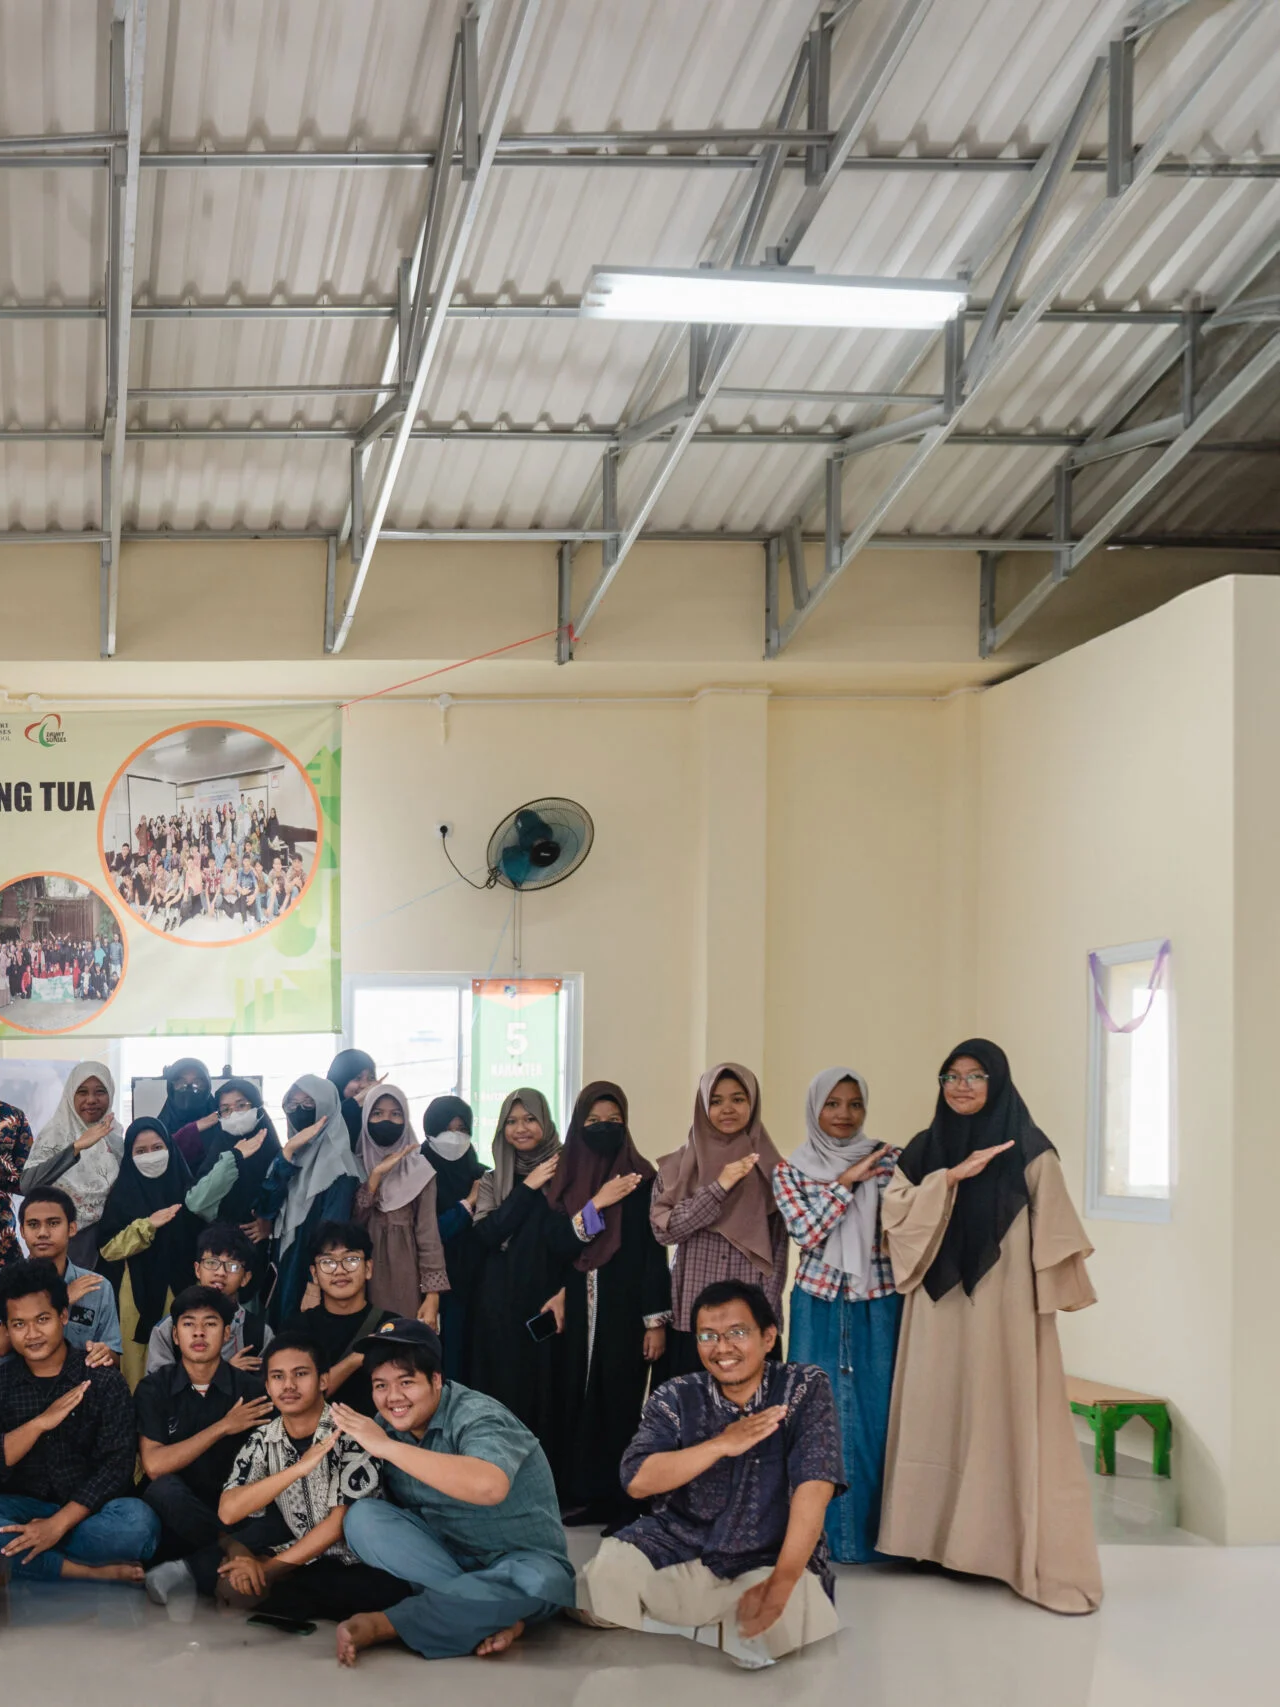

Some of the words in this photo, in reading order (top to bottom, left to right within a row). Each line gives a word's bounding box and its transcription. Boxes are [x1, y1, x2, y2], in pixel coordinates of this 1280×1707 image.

[39, 781, 95, 811] TUA
[506, 1022, 528, 1056] 5
[490, 1062, 543, 1077] KARAKTER
